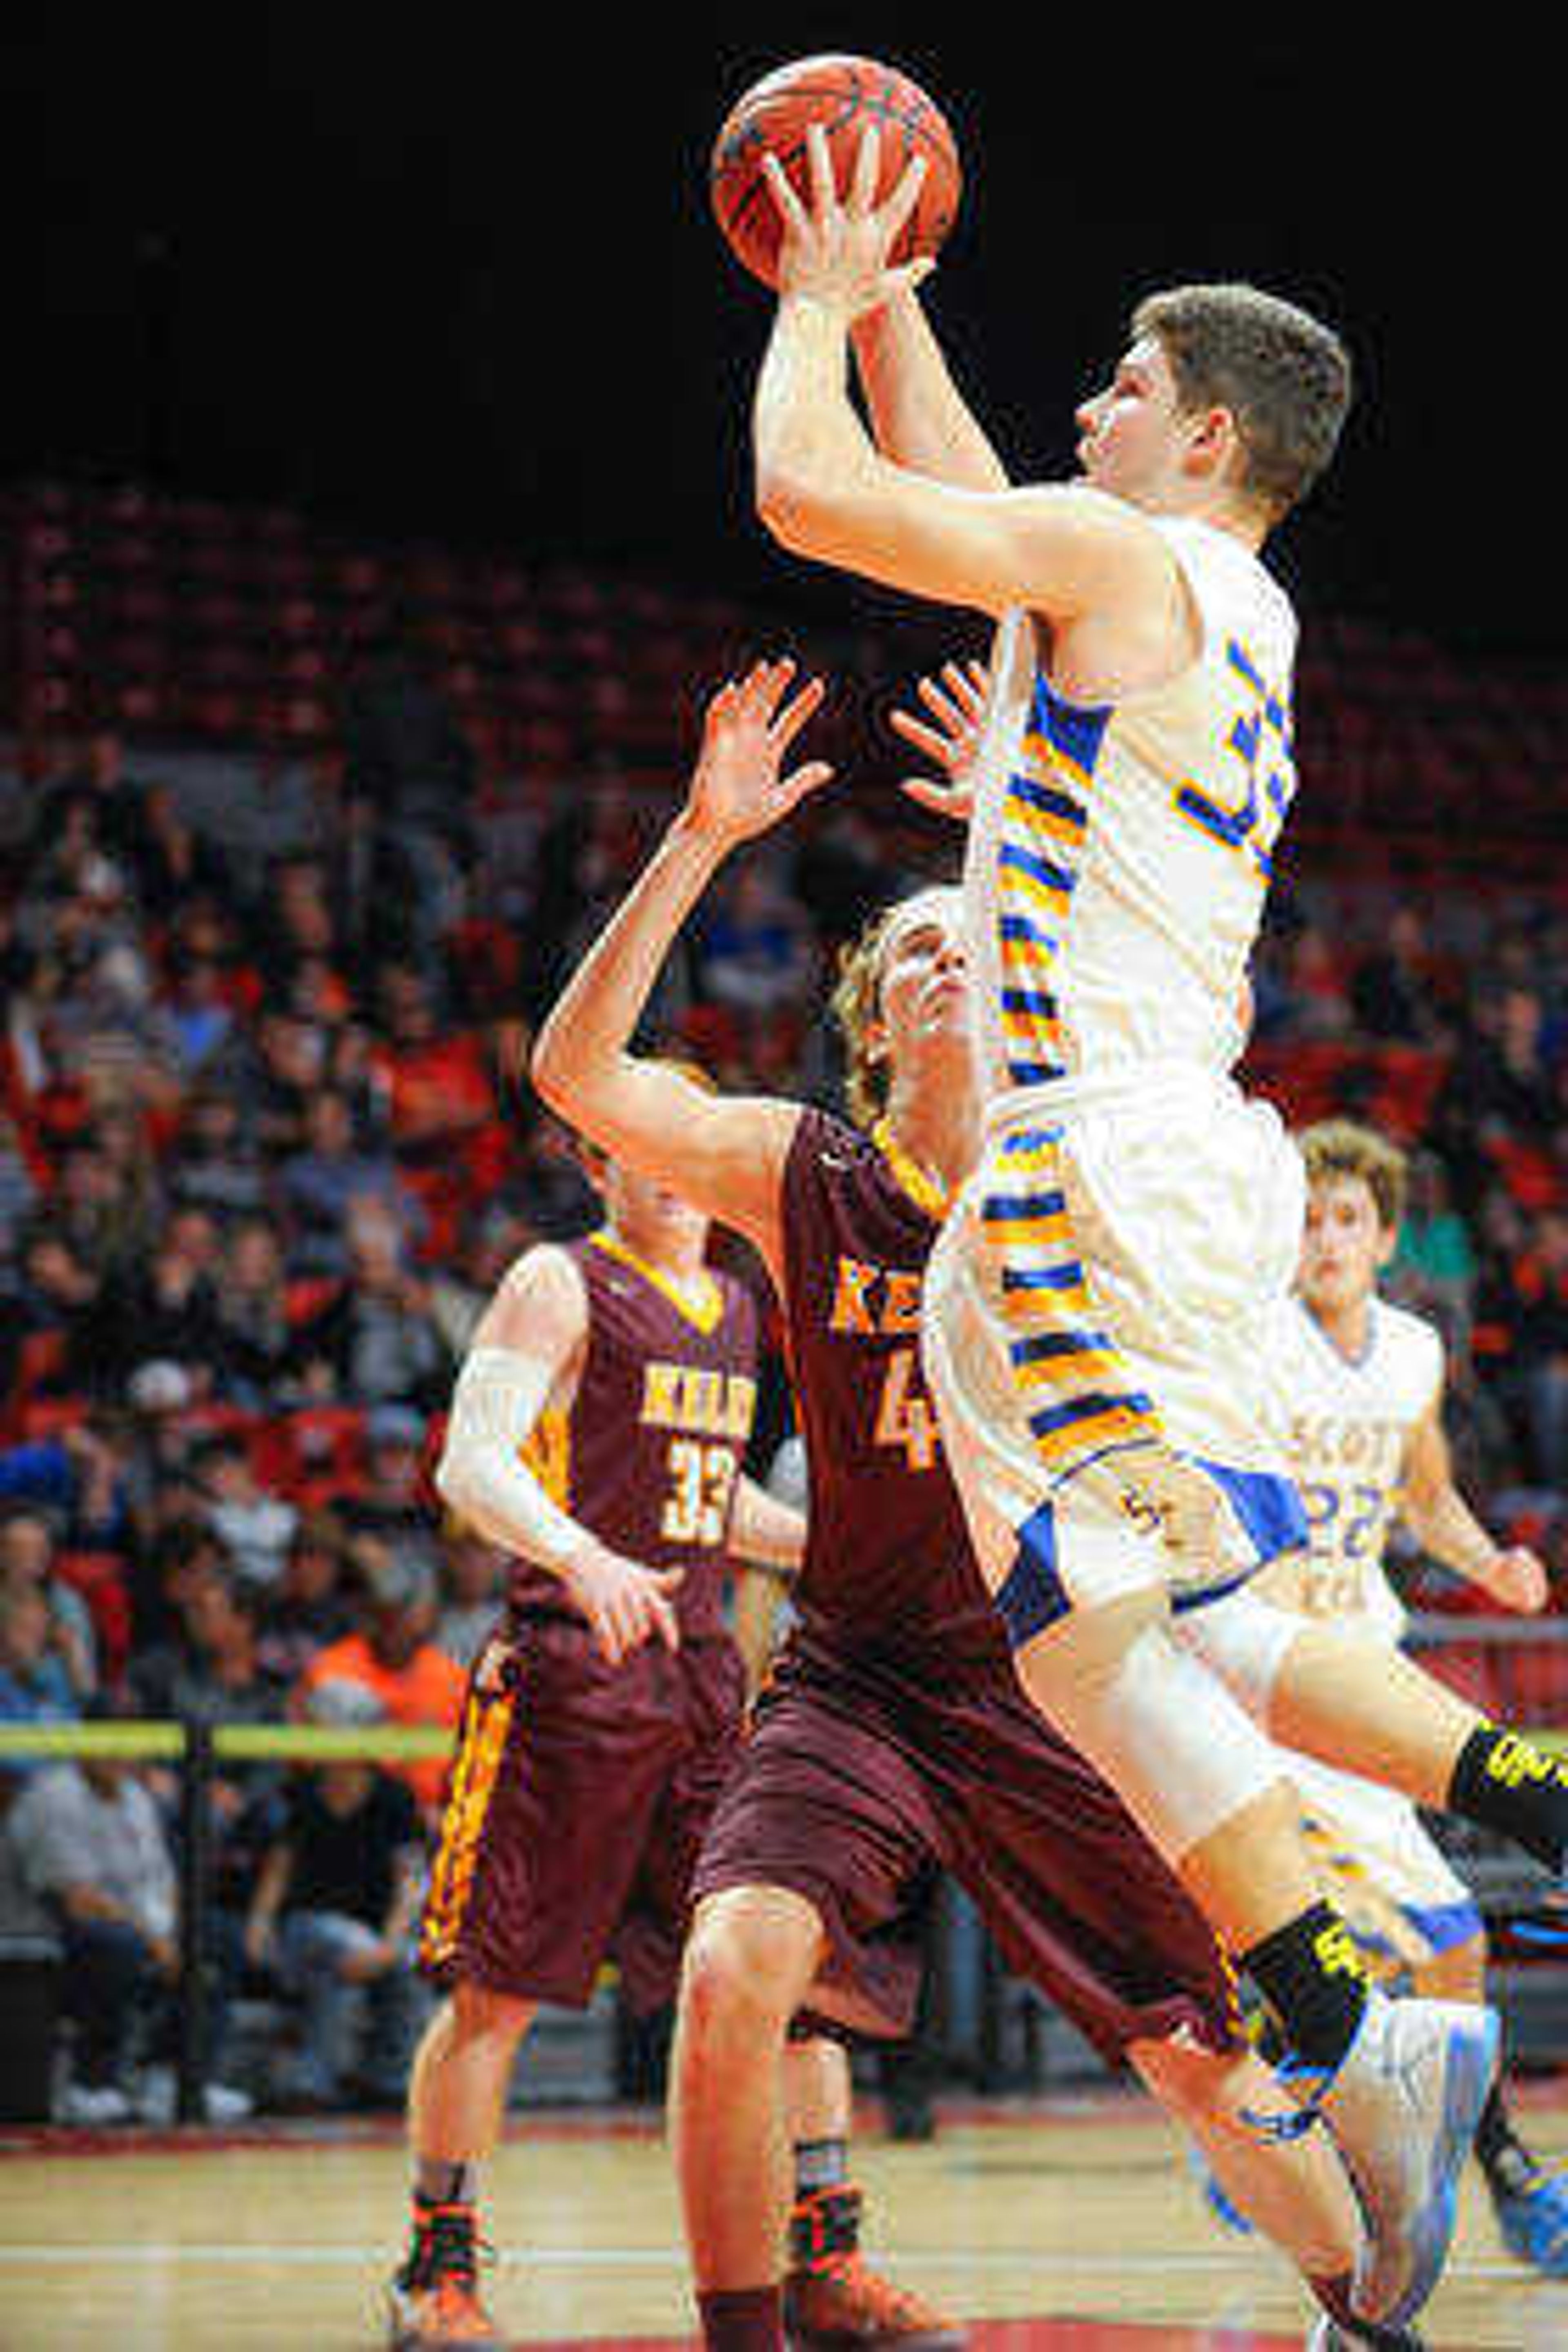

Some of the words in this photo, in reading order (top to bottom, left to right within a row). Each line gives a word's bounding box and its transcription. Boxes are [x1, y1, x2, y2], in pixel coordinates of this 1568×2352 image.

[873, 1349, 941, 1471] 4
[661, 1437, 735, 1545] 33
[1302, 1482, 1383, 1558] 22
